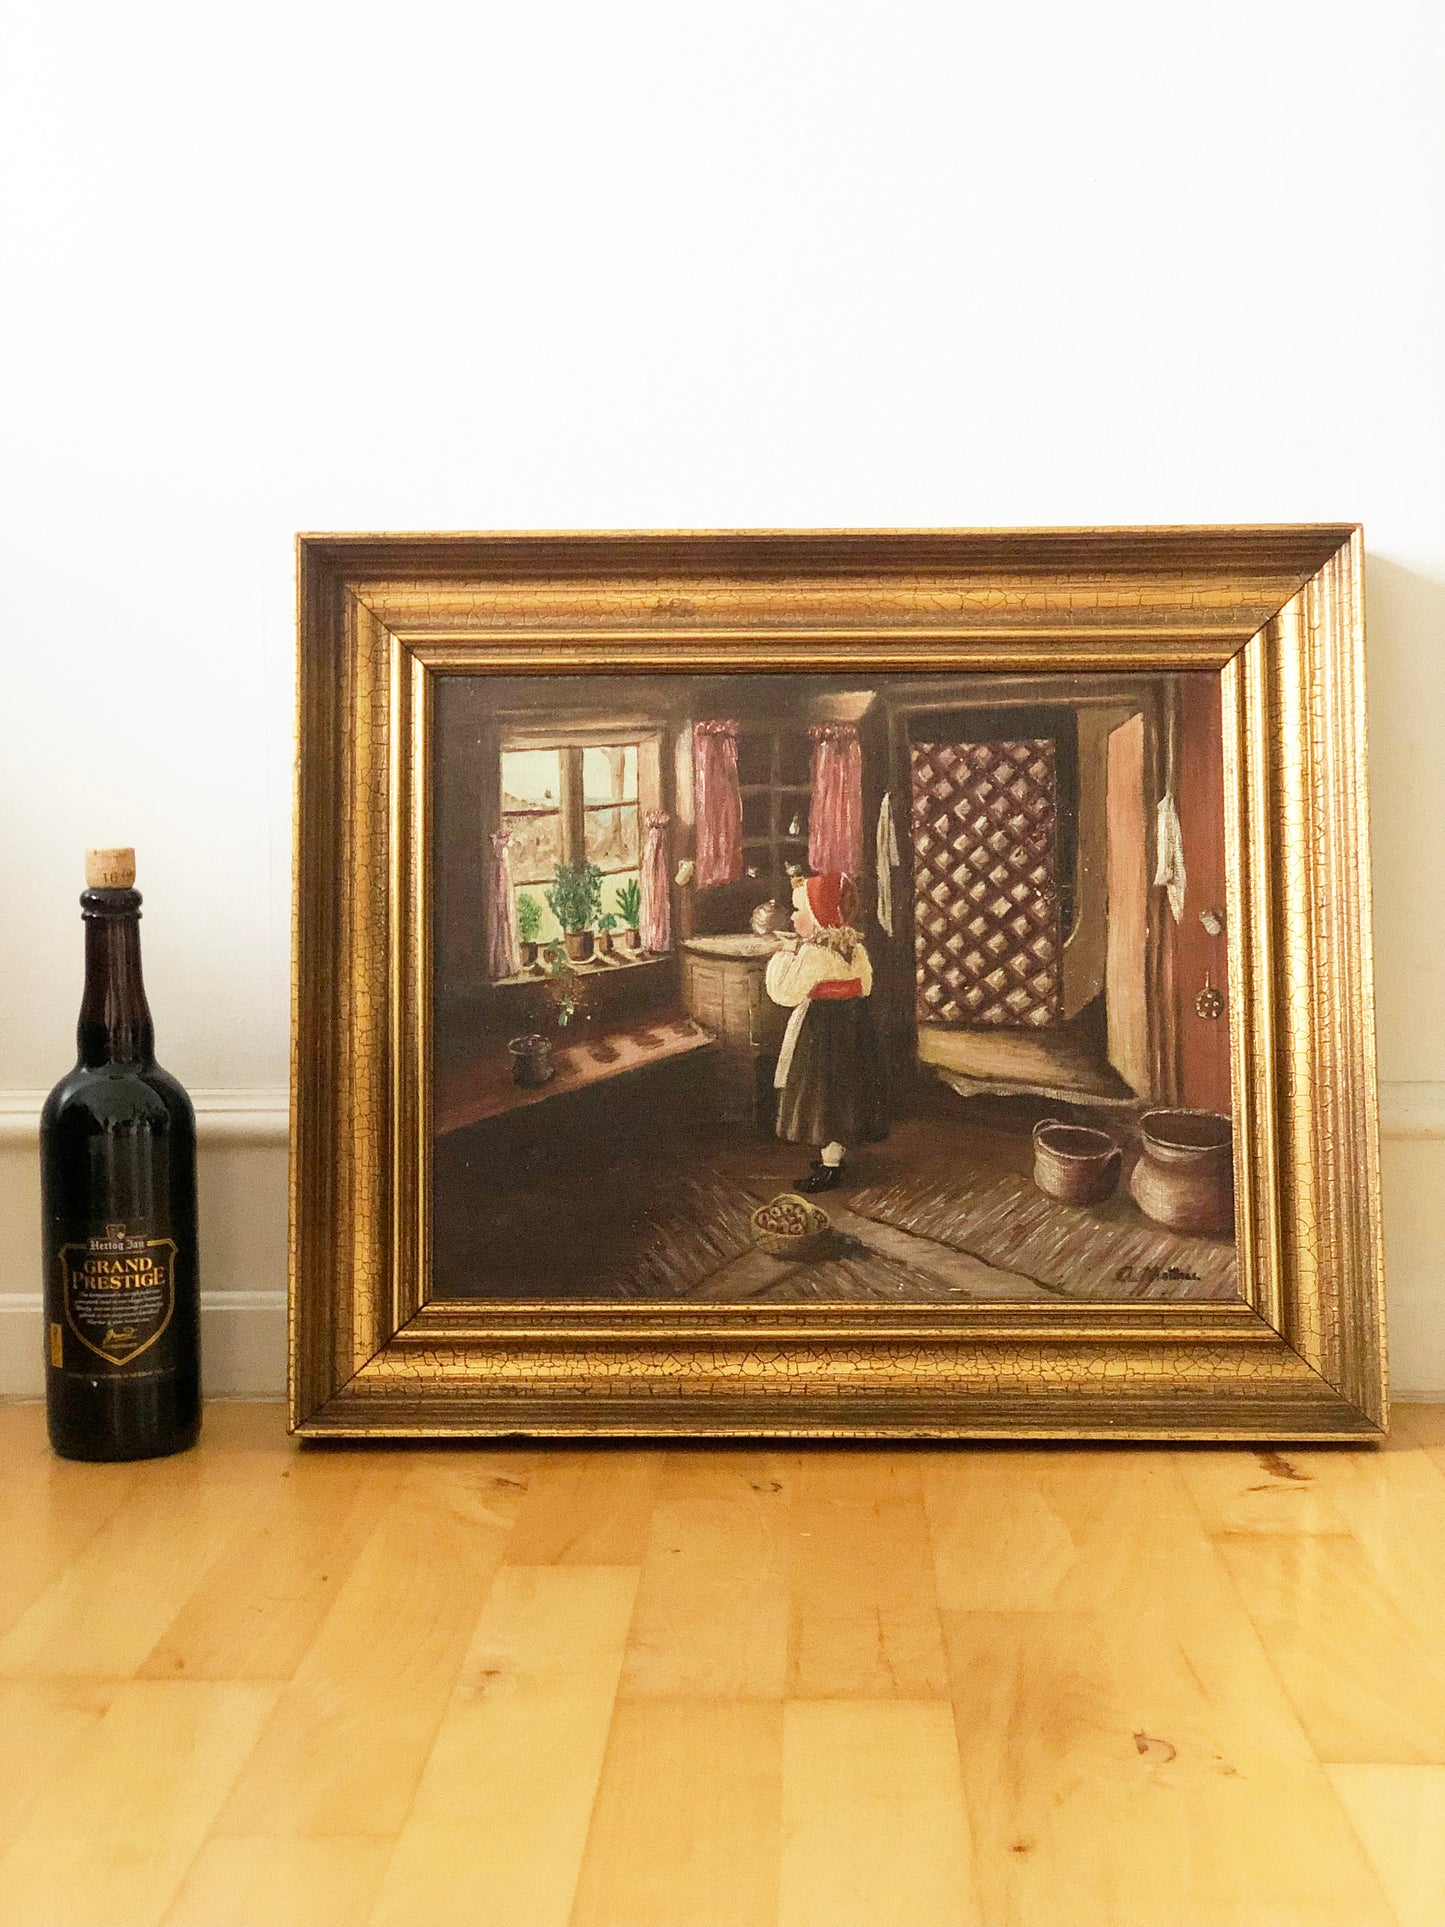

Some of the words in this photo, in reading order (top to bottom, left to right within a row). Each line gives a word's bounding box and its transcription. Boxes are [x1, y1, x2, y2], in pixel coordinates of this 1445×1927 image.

[89, 1240, 124, 1251] Hertog
[126, 1239, 145, 1250] Jan
[84, 1257, 153, 1274] GRAND
[72, 1266, 166, 1290] PRESTIGE
